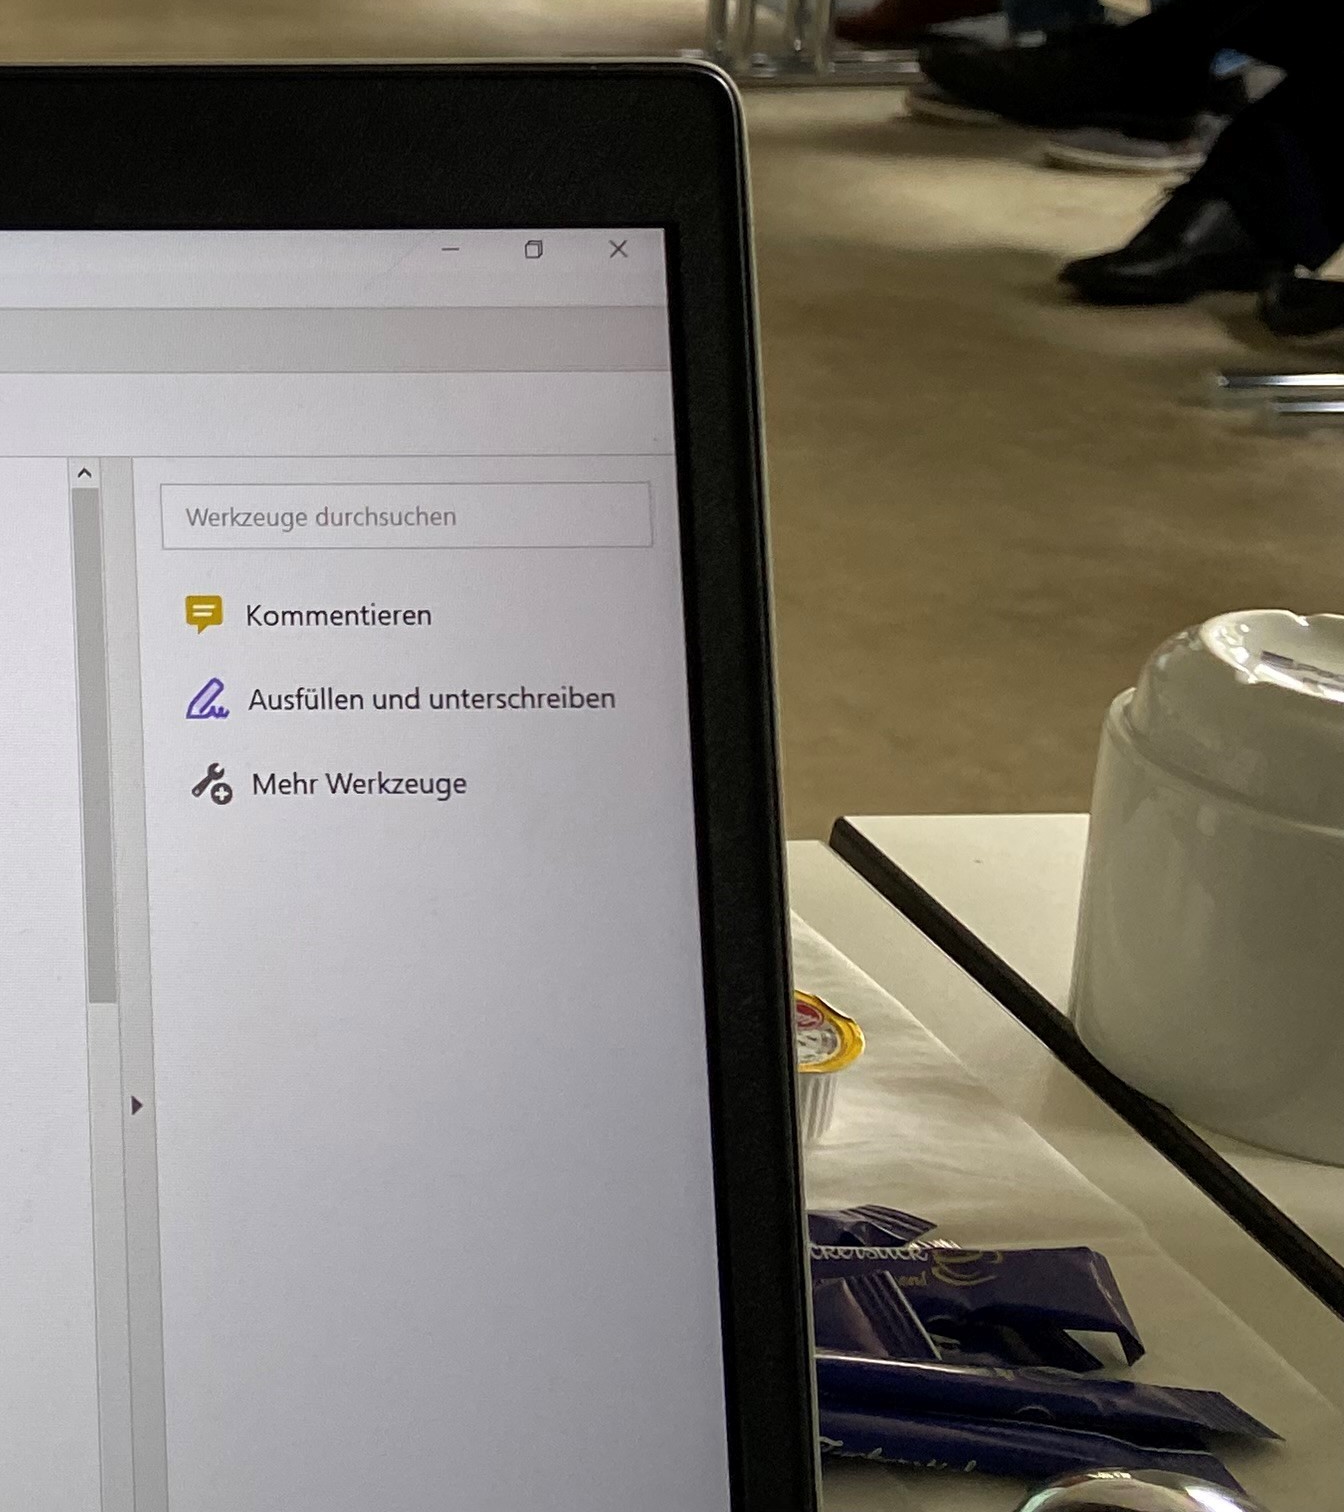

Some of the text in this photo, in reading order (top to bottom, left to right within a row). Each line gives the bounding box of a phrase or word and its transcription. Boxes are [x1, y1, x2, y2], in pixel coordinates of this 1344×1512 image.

[185, 505, 457, 533] Werkzeuge durchsuchen
[246, 602, 432, 627] Kommentieren
[248, 685, 616, 711] Ausfüllen und unterschreiben
[252, 770, 467, 802] Mehr Werkzeuge
